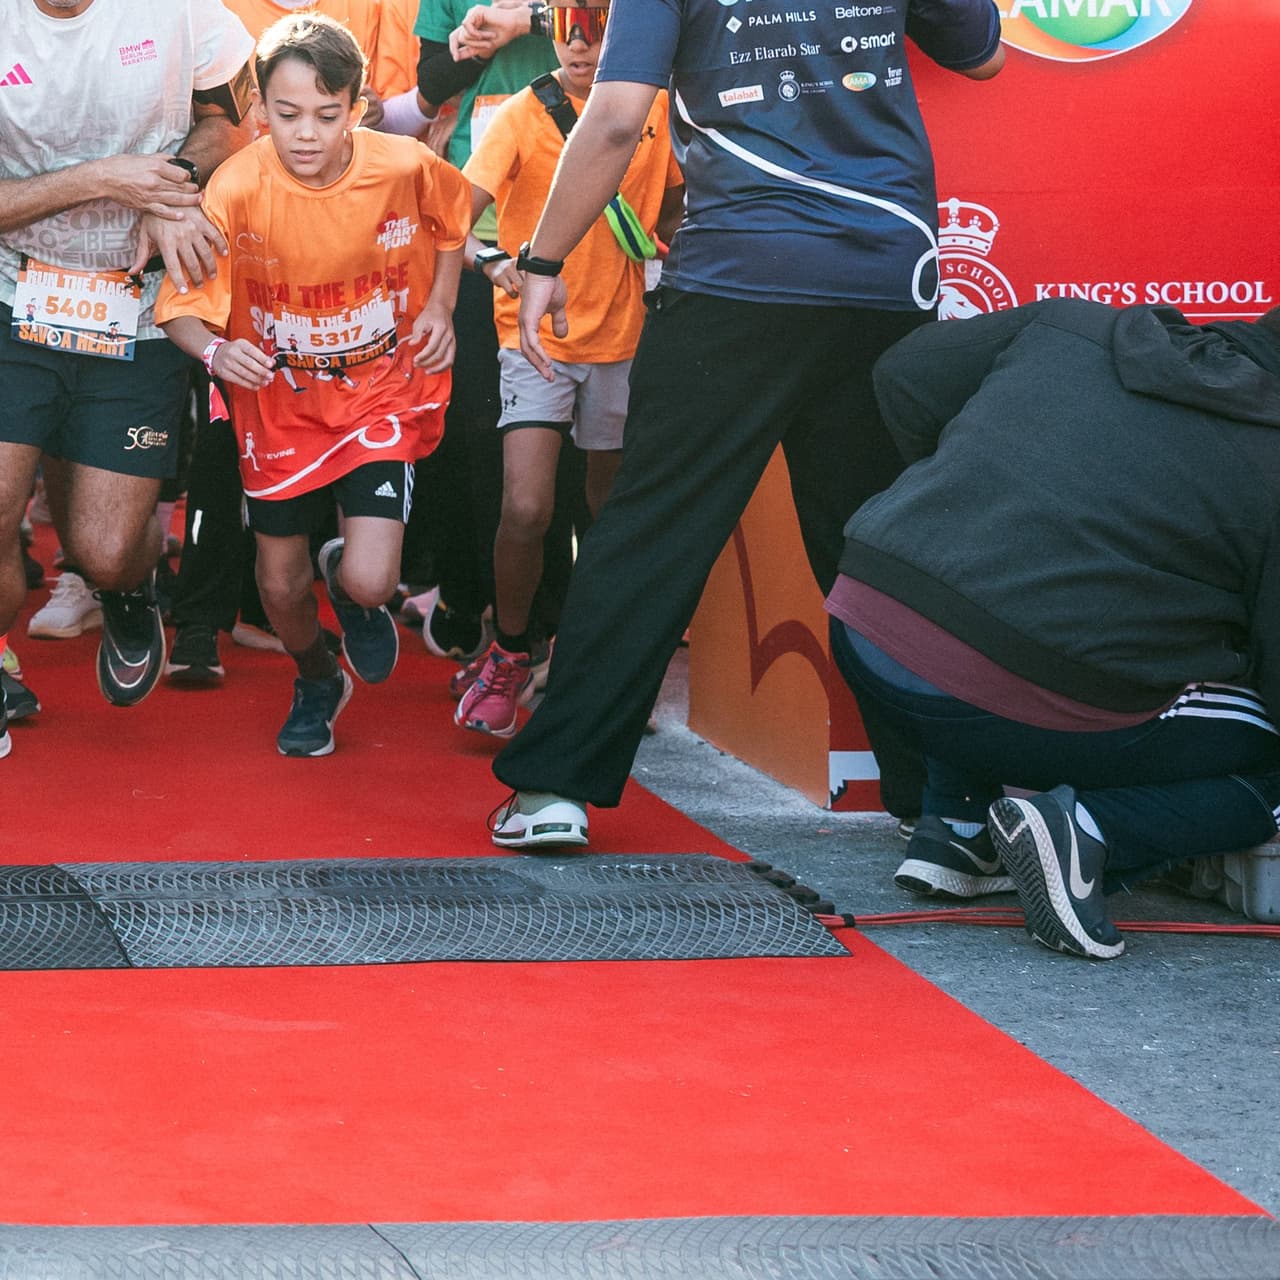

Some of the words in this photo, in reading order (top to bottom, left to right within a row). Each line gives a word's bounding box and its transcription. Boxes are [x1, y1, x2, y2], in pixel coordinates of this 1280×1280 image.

[748, 15, 782, 27] PALM
[785, 11, 817, 24] HILLS
[835, 5, 883, 19] Beltone
[860, 32, 896, 49] smart
[729, 51, 752, 65] Ezz
[755, 44, 797, 61] Elarab
[800, 43, 822, 57] Star
[384, 216, 410, 228] THE
[376, 222, 419, 246] HEART
[26, 269, 59, 288] RUN
[63, 274, 91, 290] THE
[946, 262, 1011, 311] SCHOOL
[297, 280, 345, 310] THE
[1035, 281, 1137, 305] KING'S
[1144, 280, 1272, 305] SCHOOL
[45, 295, 108, 322] 5408
[281, 310, 314, 328] RUN
[315, 313, 346, 328] THE
[350, 293, 384, 323] RACE
[60, 329, 73, 350] A
[309, 325, 364, 348] 5317
[329, 353, 343, 369] A
